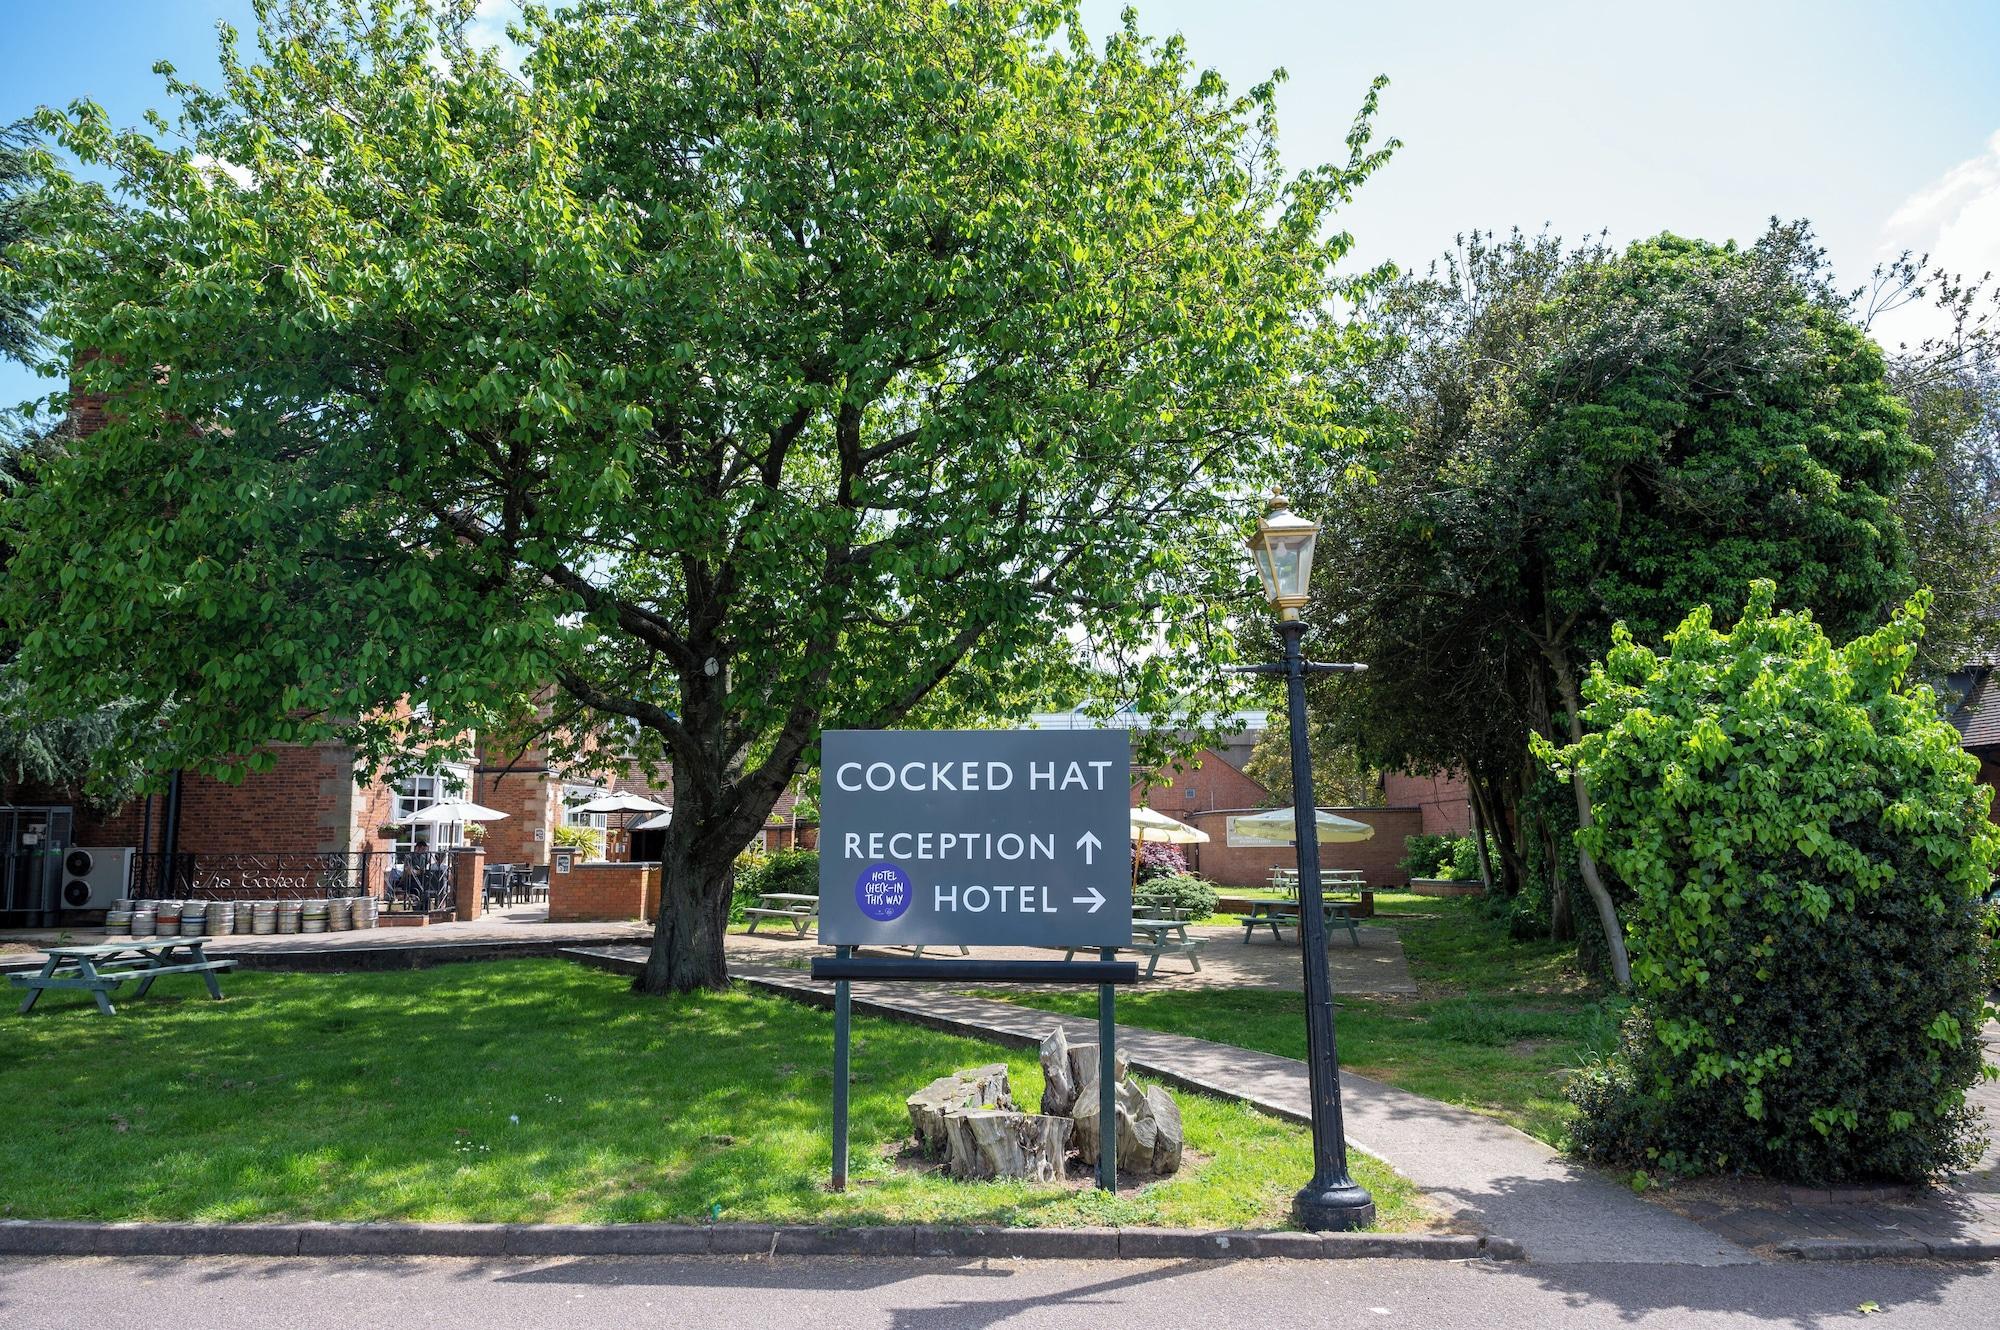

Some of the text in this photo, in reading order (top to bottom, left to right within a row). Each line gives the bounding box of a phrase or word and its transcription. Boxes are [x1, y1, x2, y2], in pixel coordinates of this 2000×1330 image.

[837, 761, 1112, 791] COCKED HAT
[844, 833, 1055, 860] RECEPTION
[192, 870, 230, 889] The
[241, 870, 309, 889] Cocked
[872, 870, 897, 881] HOTEL
[865, 882, 904, 894] CHECK-IN
[865, 893, 904, 905] THIS WAY
[934, 886, 1058, 913] HOTEL
